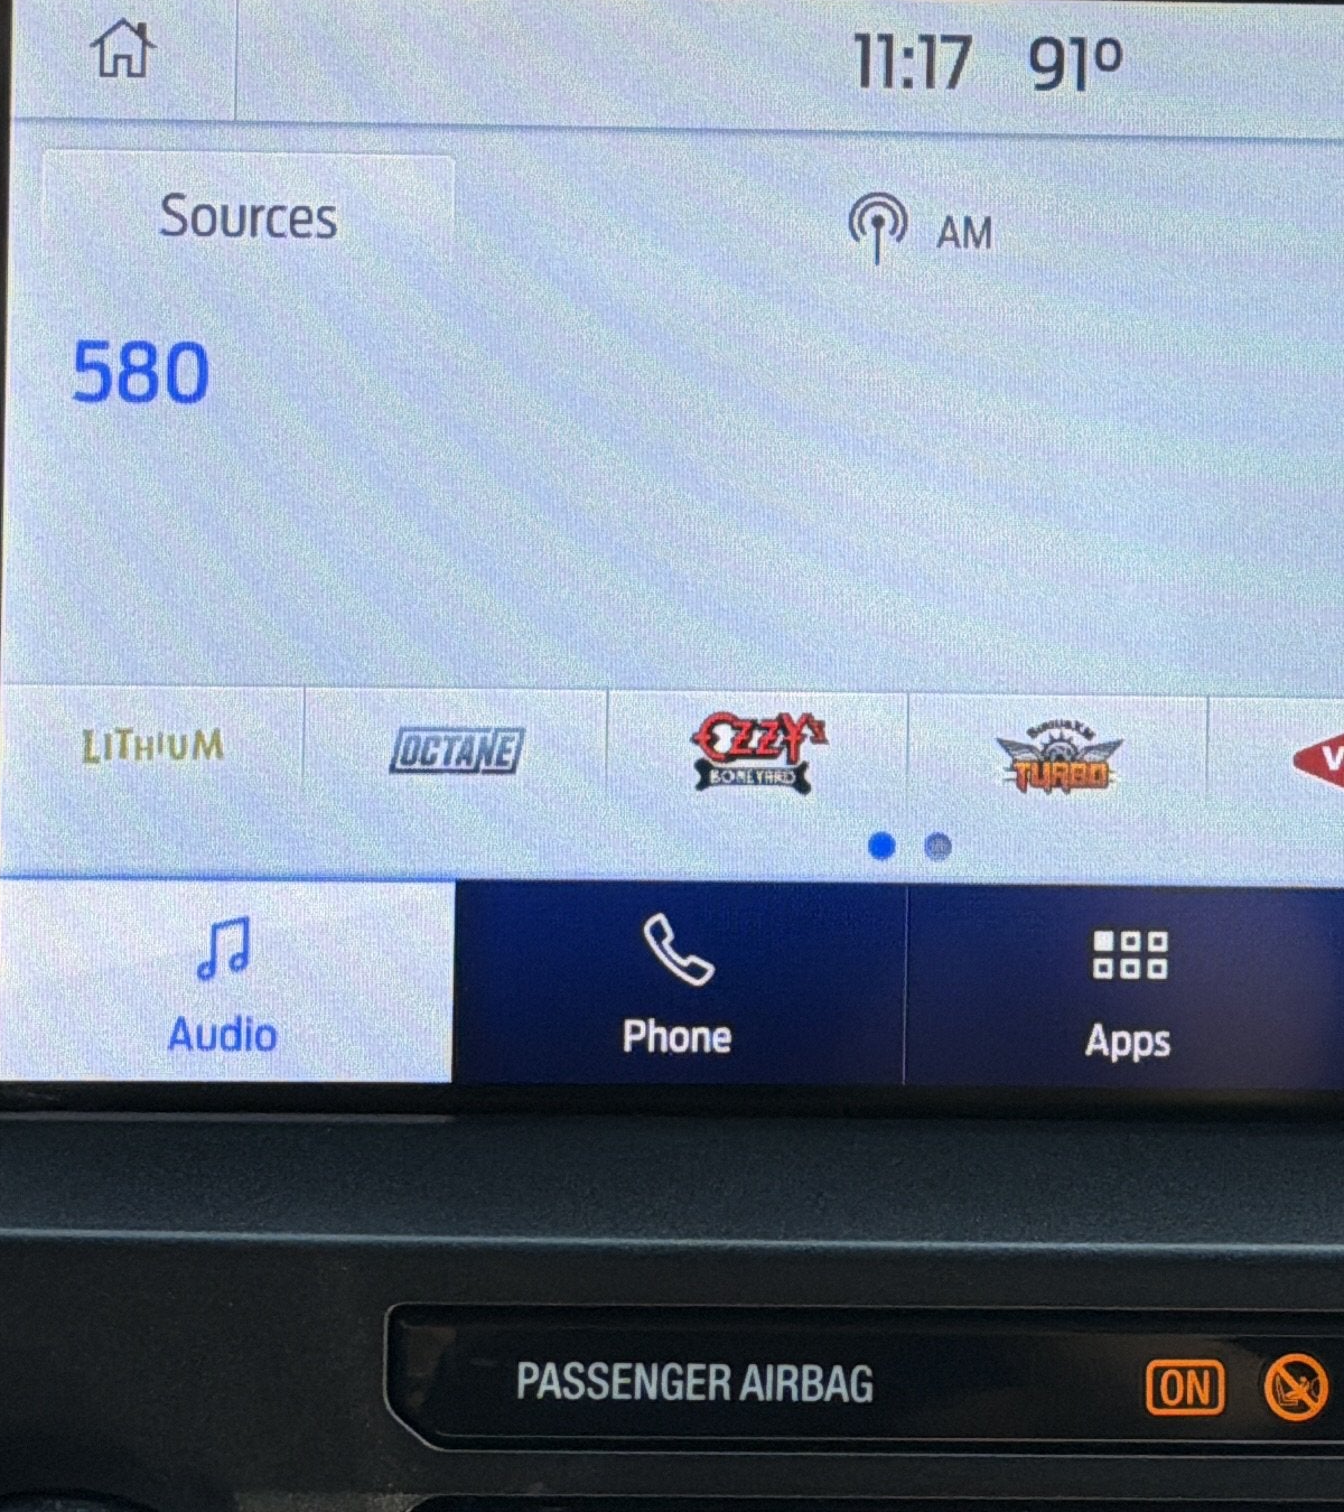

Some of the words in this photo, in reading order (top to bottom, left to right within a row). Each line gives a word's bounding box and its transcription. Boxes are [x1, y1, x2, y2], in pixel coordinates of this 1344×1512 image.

[854, 31, 973, 91] 11:17
[159, 192, 339, 239] Sources
[936, 214, 993, 251] AM
[72, 340, 210, 404] 580
[82, 727, 225, 764] LITHIUM
[400, 734, 516, 767] OCTANE
[1013, 760, 1110, 795] TURBO
[168, 1014, 278, 1053] Audio
[622, 1018, 732, 1056] Phone
[1085, 1024, 1171, 1064] Apps
[516, 1361, 731, 1402] PASSENGER
[740, 1364, 874, 1405] AIRBAG
[1160, 1368, 1211, 1408] ON
